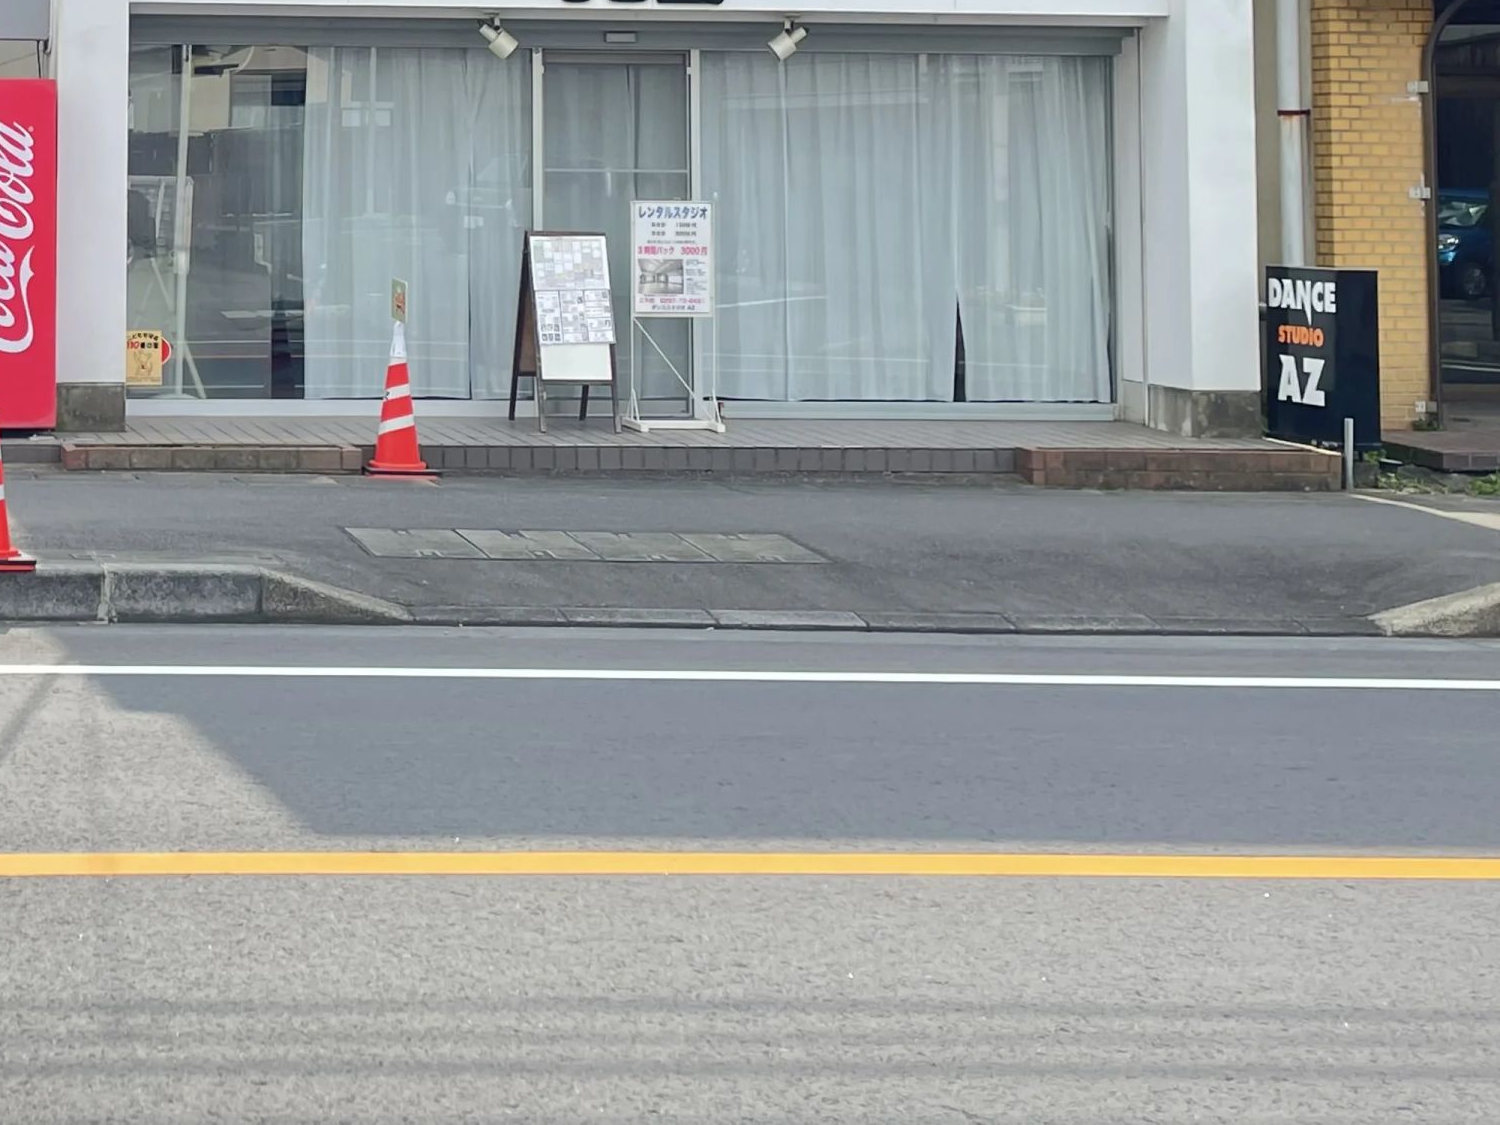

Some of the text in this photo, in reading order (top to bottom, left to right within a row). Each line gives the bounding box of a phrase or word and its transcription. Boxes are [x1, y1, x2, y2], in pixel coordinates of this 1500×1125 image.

[638, 206, 708, 219] レンタルスタジオ
[1268, 277, 1337, 325] DANCE
[1277, 324, 1325, 348] STUDIO
[1277, 354, 1326, 407] AZ
